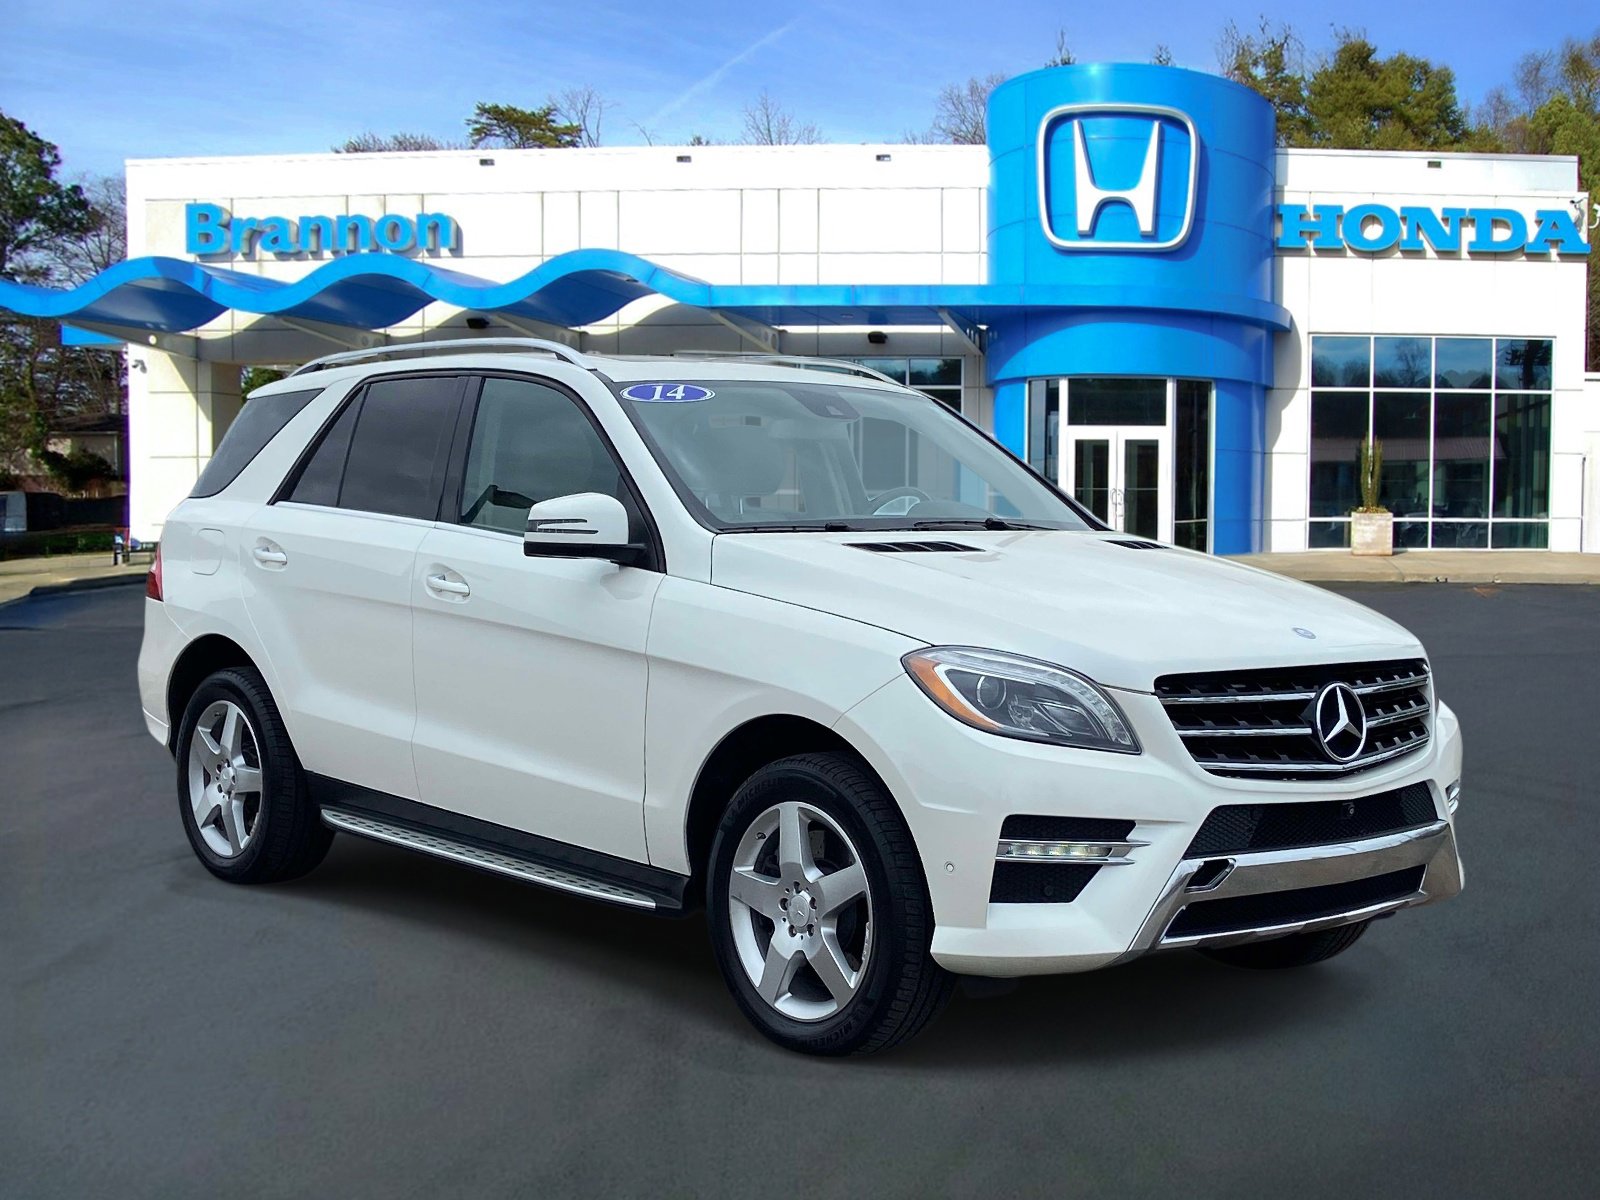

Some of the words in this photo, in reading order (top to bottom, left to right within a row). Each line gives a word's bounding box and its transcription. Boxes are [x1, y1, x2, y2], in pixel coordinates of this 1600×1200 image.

[186, 203, 455, 255] Brannon
[1276, 204, 1591, 254] HONDA
[651, 385, 685, 400] 14
